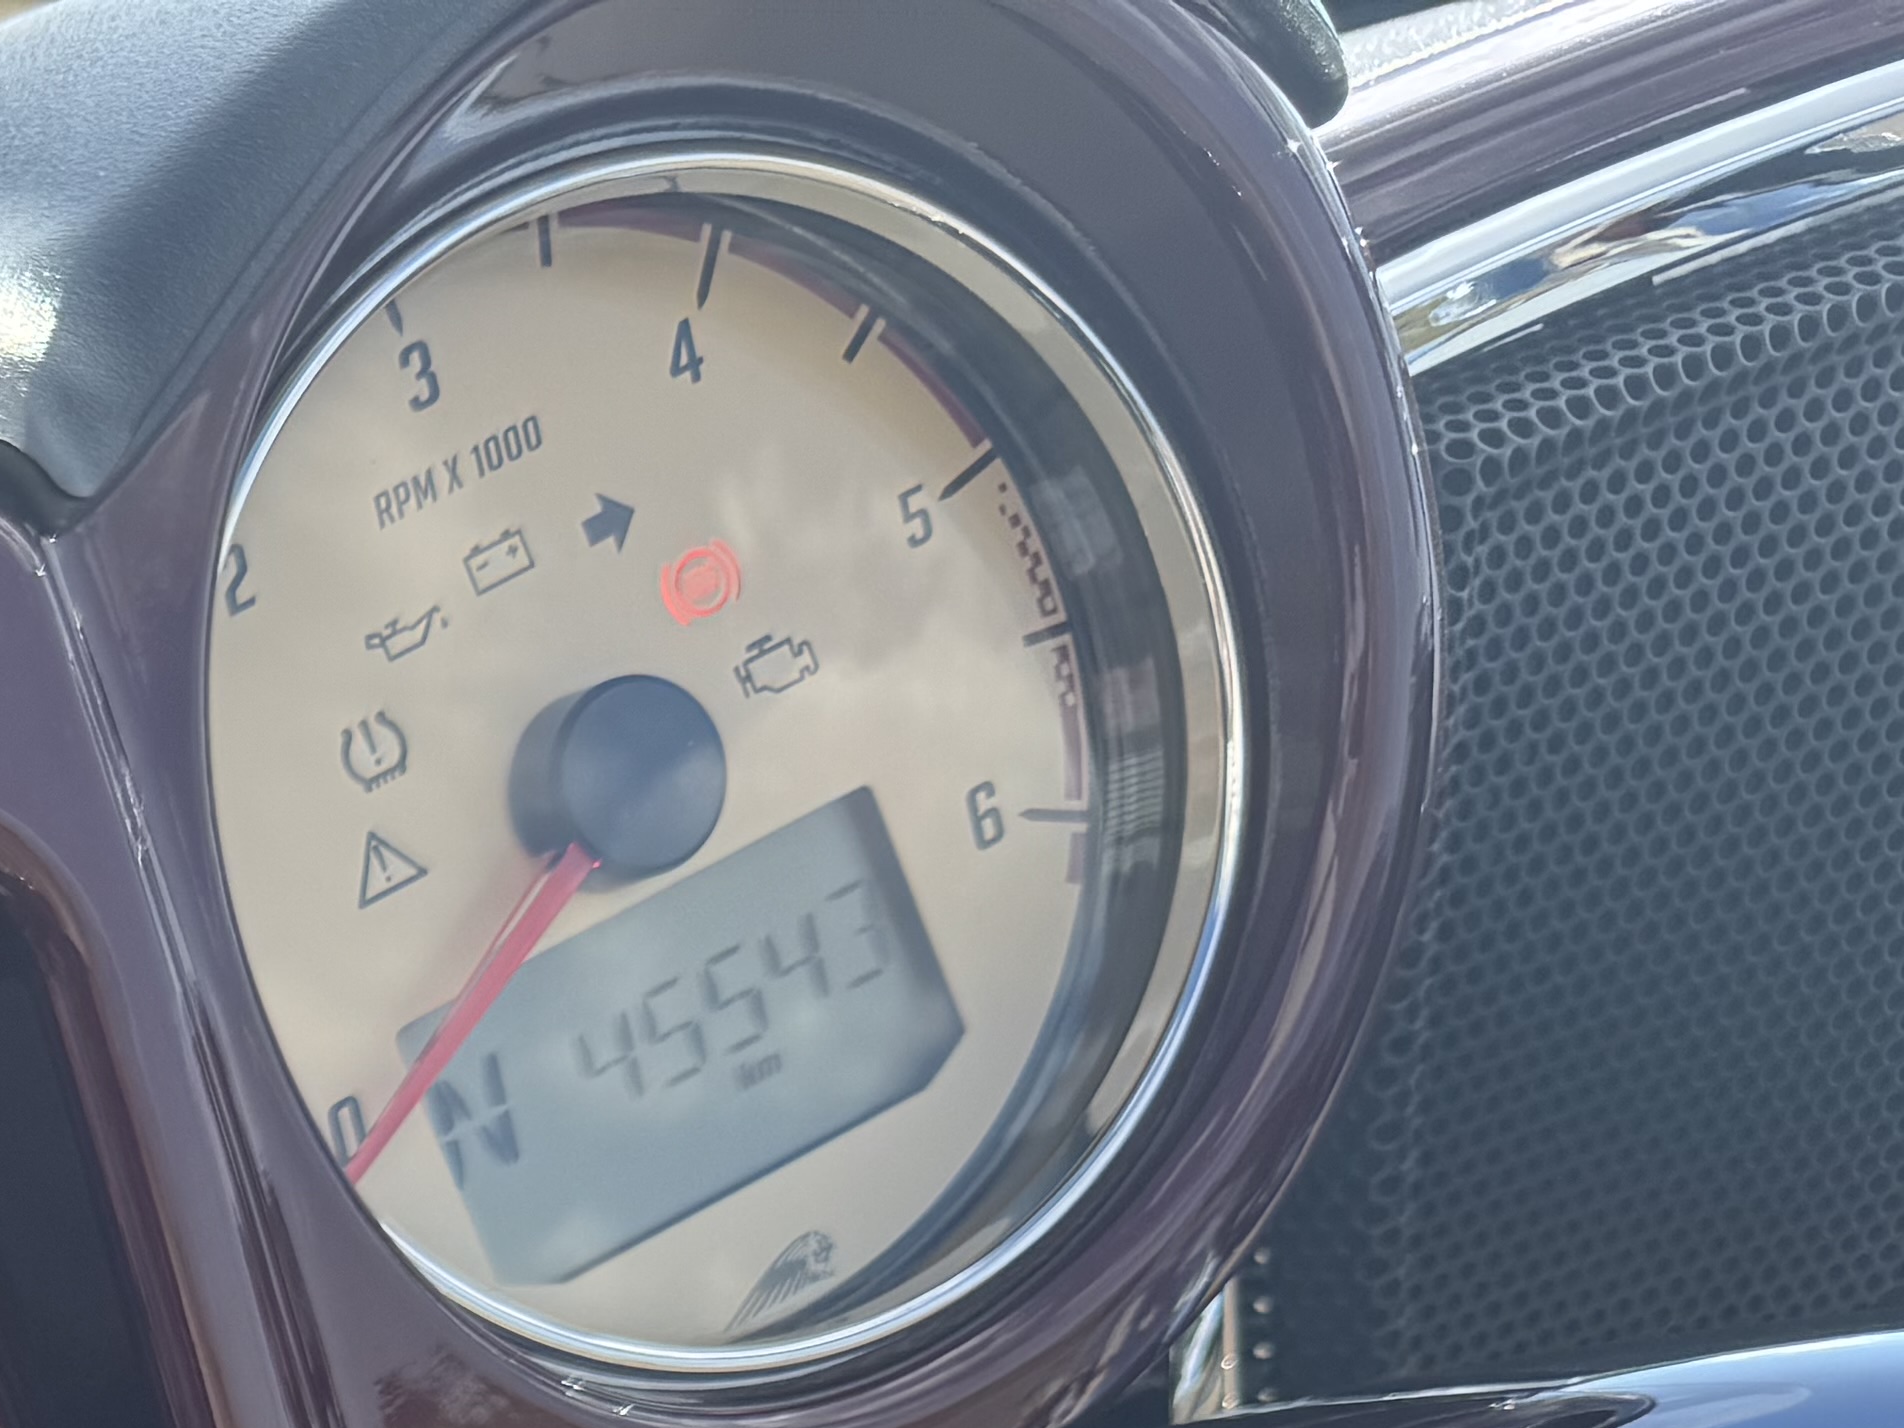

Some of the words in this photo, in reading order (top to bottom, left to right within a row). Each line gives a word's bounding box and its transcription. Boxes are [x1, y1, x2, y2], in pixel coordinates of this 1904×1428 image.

[398, 338, 442, 412] 3
[667, 317, 704, 383] 4
[372, 464, 440, 531] RPM
[438, 452, 463, 494] X
[469, 414, 545, 486] 1000
[896, 482, 934, 548] 5
[222, 543, 256, 616] 2
[965, 780, 1004, 850] 6
[571, 878, 892, 1101] 45543
[434, 1051, 522, 1192] N
